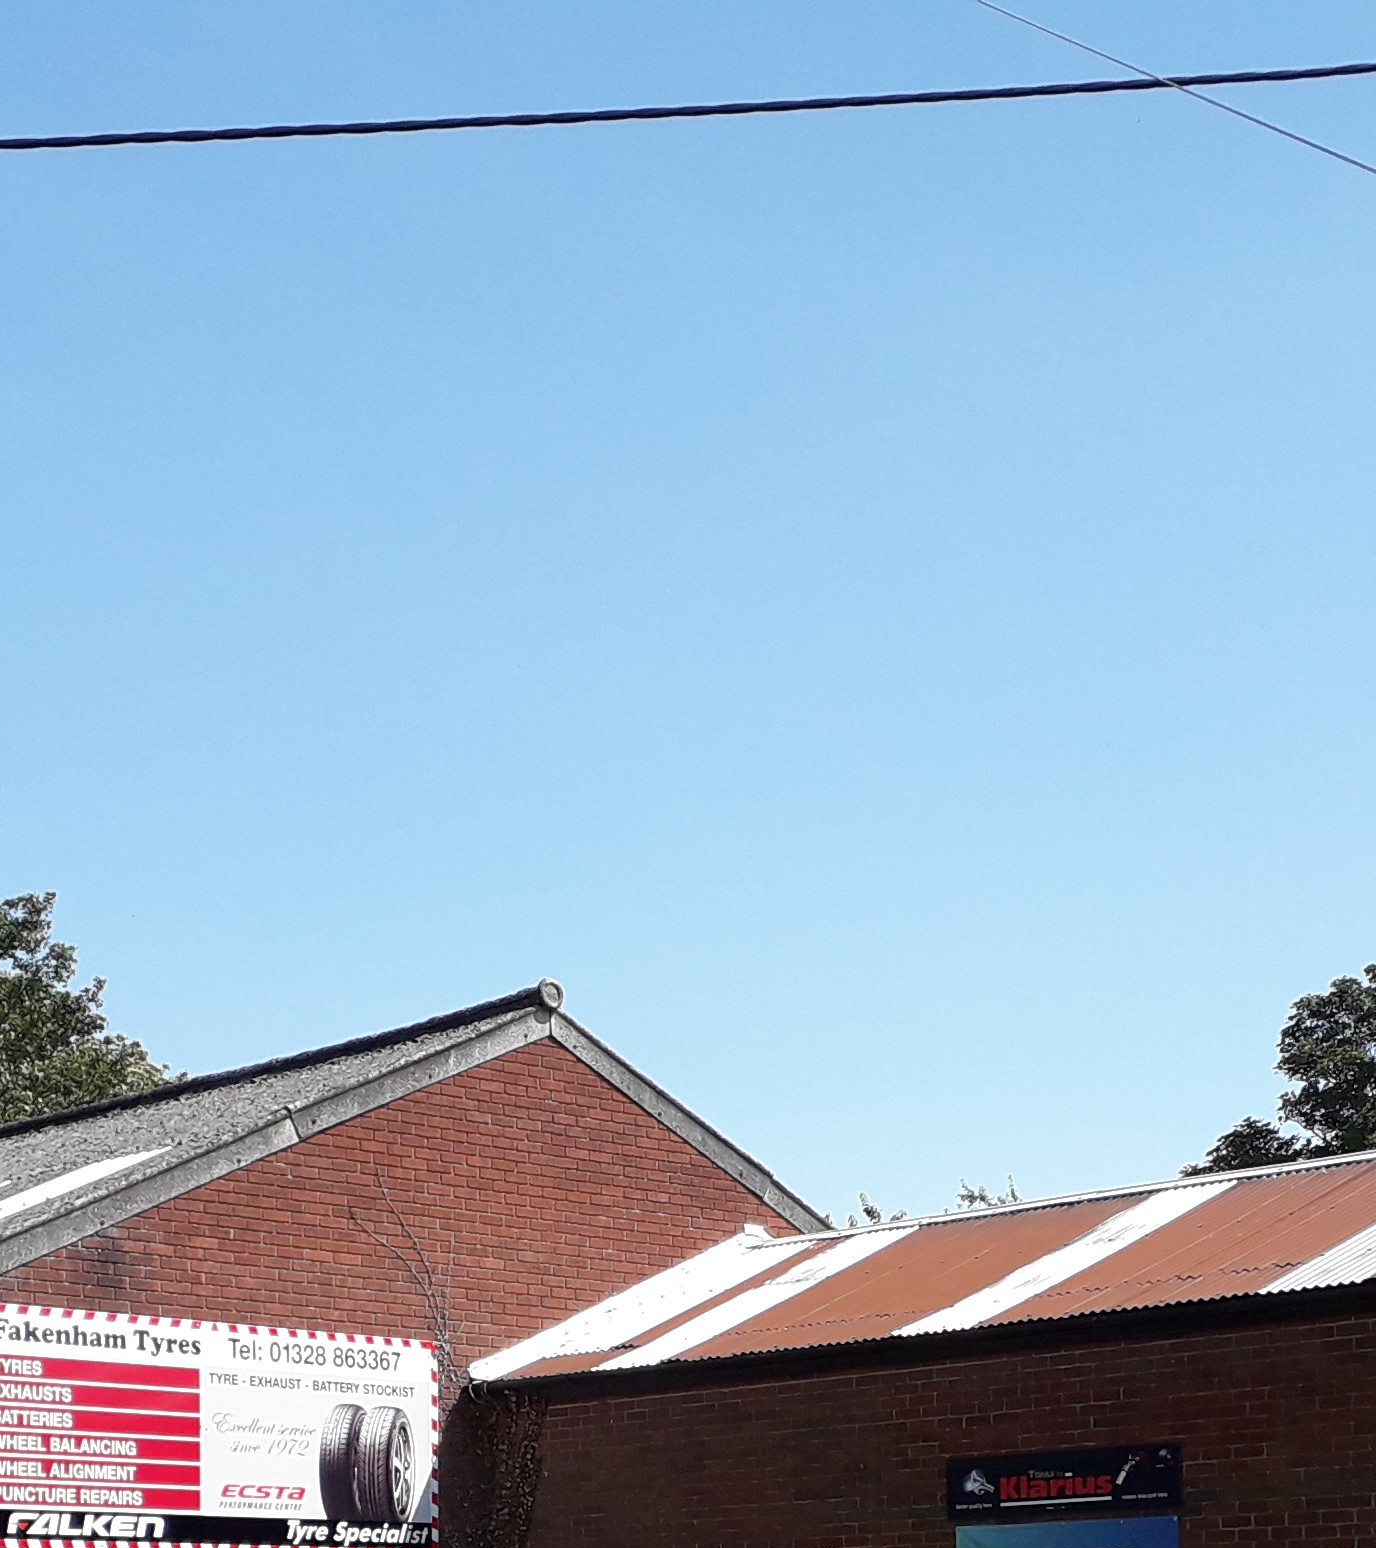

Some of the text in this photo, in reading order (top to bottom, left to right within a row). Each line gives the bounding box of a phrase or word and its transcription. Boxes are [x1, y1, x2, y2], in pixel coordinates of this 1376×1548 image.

[133, 1329, 201, 1357] Tyres
[228, 1338, 401, 1371] Tel: 01328 863367
[209, 1372, 239, 1385] TYRE
[249, 1376, 302, 1390] EXHAUST
[312, 1380, 360, 1394] BATTERY
[363, 1383, 415, 1398] STOCKIST
[50, 1436, 137, 1456] BALANCING
[267, 1439, 310, 1457] 1972
[50, 1462, 137, 1481] ALIGNMENT
[80, 1488, 144, 1506] REPAIRS
[999, 1474, 1114, 1500] Klarius
[6, 1512, 428, 1547] FALKEN Tyre Specialist
